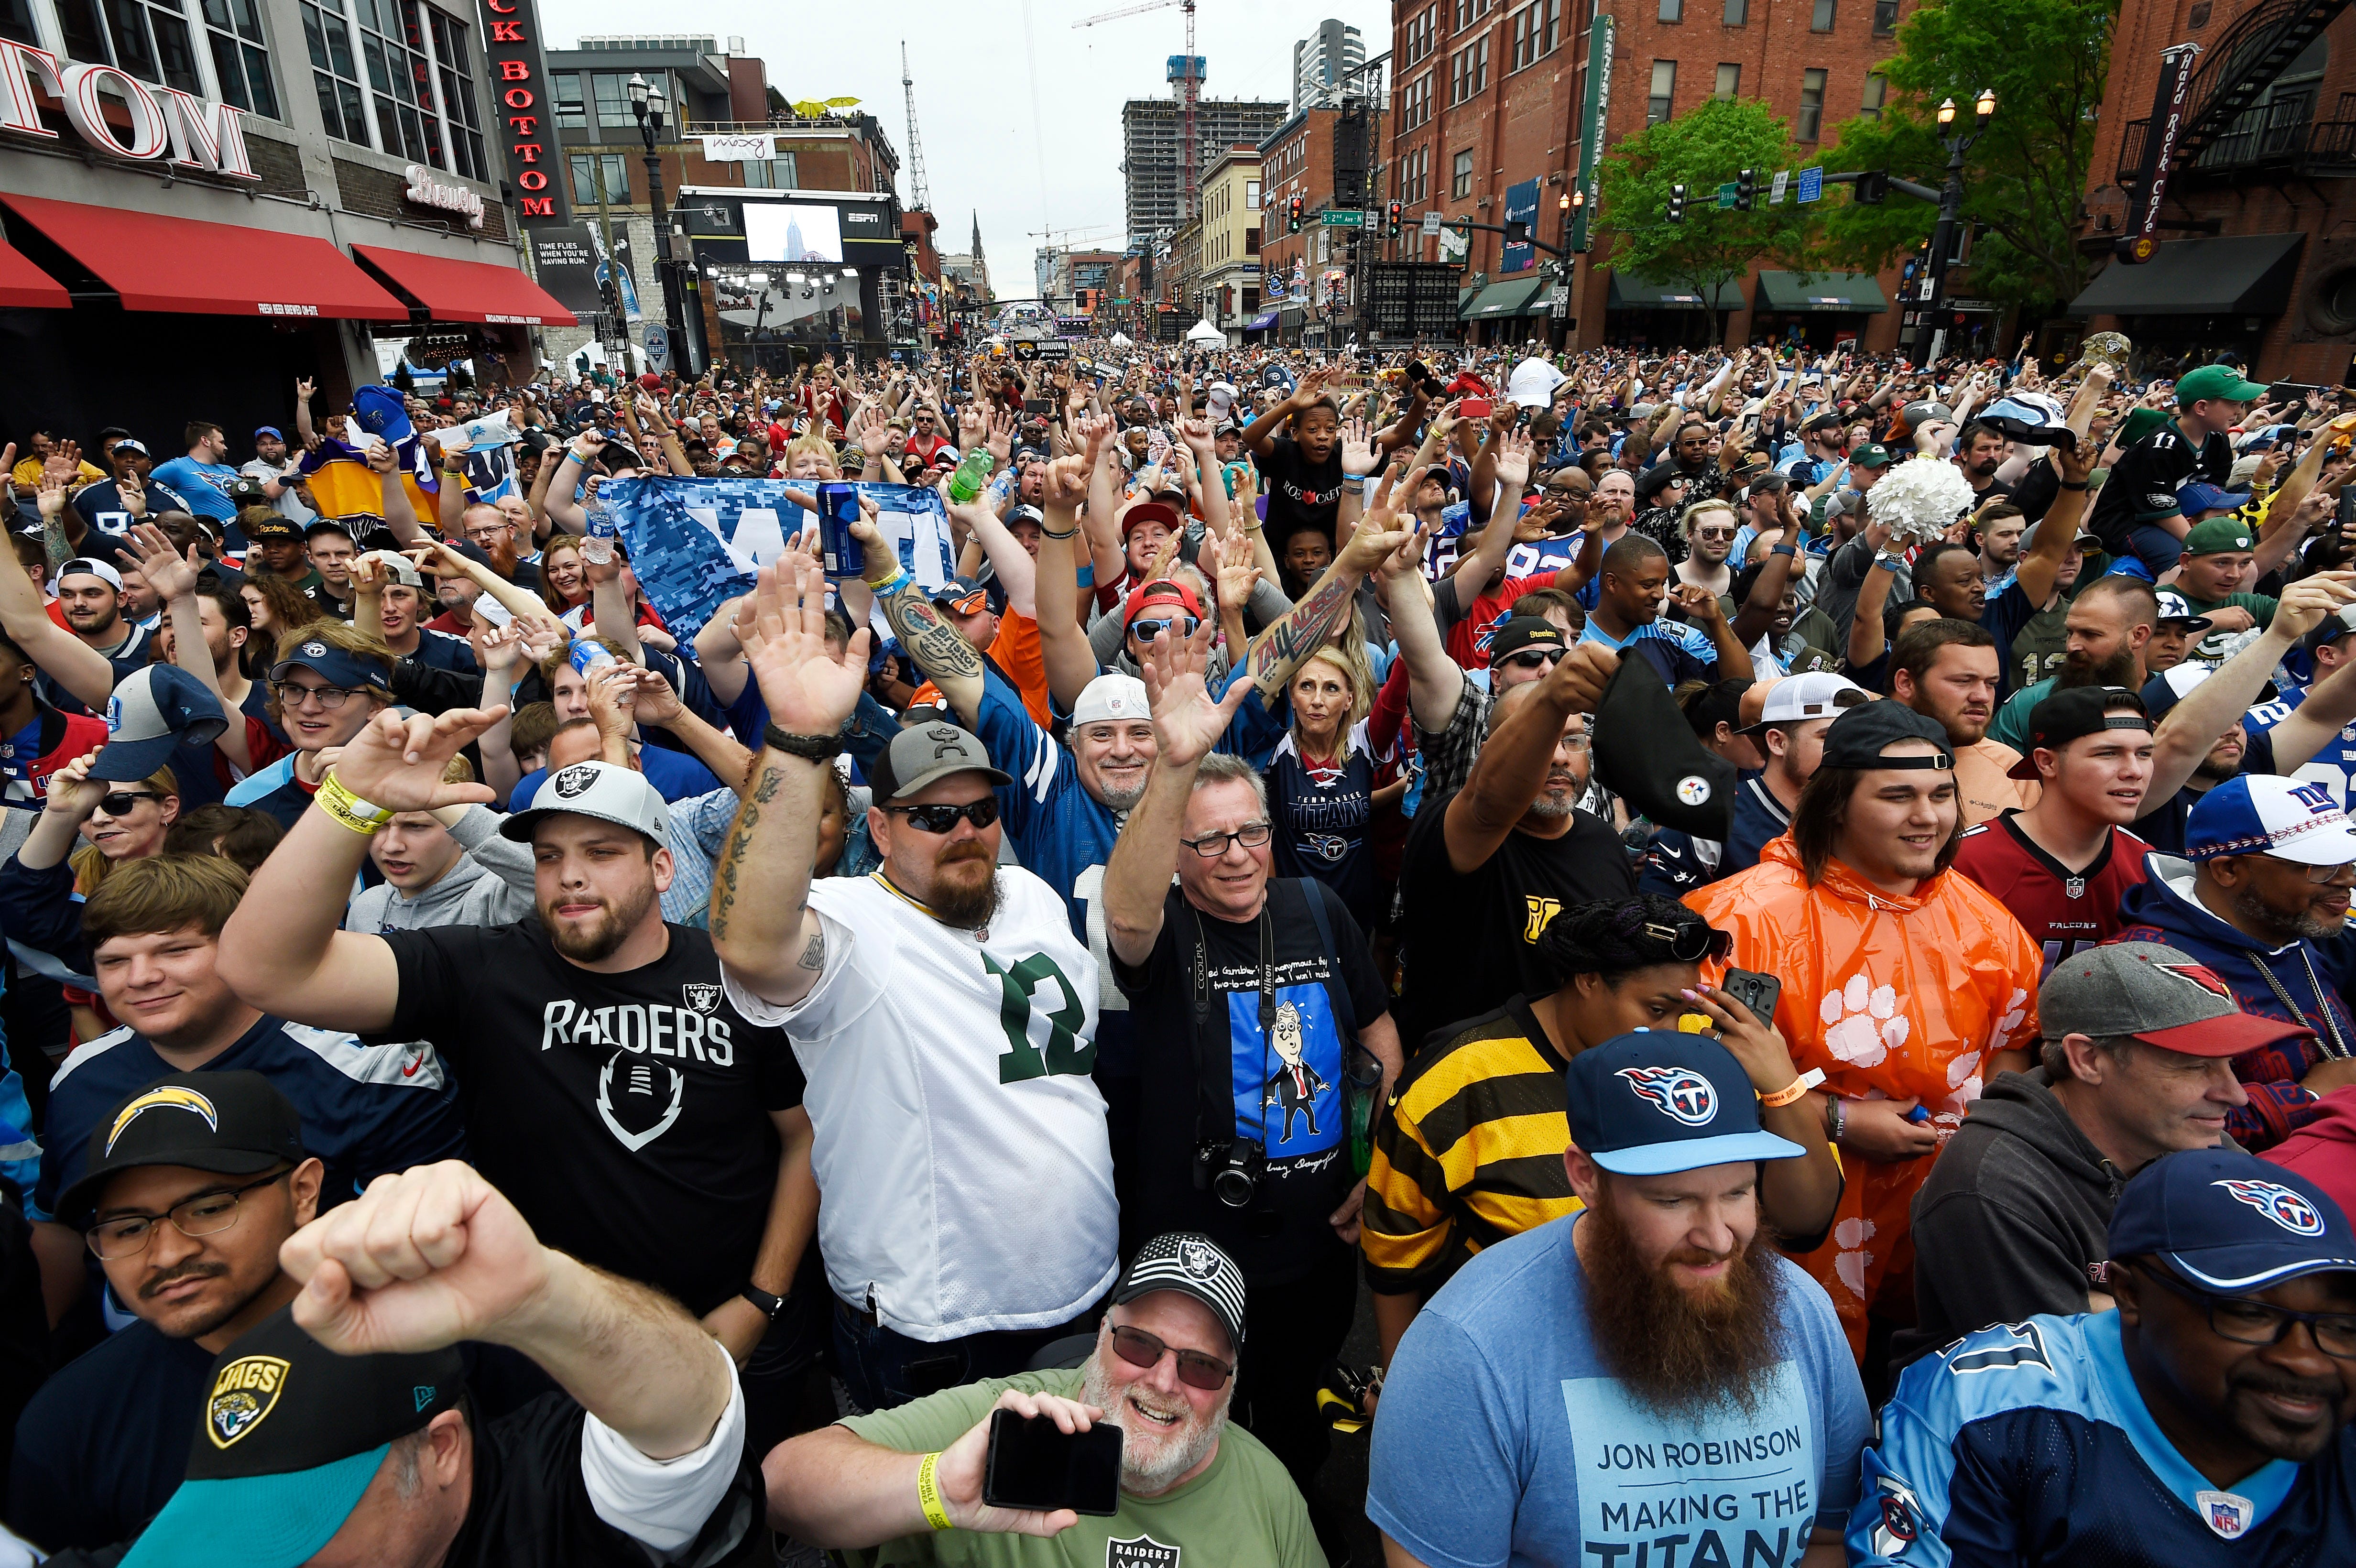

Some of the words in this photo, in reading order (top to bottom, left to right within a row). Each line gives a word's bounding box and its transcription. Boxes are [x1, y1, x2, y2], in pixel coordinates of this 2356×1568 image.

[2181, 54, 2193, 105] Hard
[499, 60, 556, 216] BOTTOM
[2159, 114, 2179, 171] Rock
[406, 164, 484, 229] Brewery
[2145, 180, 2164, 233] Cafe
[848, 213, 878, 223] ESPN
[541, 258, 568, 266] HAVING
[569, 257, 588, 265] RUM.
[563, 250, 589, 258] YOU'RE
[258, 303, 273, 314] FRESH
[273, 305, 284, 315] BEER
[284, 305, 302, 315] BREWED
[1036, 341, 1068, 351] #DUUUVAL
[1094, 362, 1124, 378] #DUUUVAL
[2152, 432, 2176, 450] 11
[259, 524, 290, 535] Packers
[1255, 576, 1348, 677] TALLADEGA
[1530, 630, 1557, 639] Steelers
[927, 632, 947, 647] Motor
[945, 646, 970, 670] Speedway
[934, 625, 977, 669] Bristol
[1287, 799, 1370, 830] TITANS
[1586, 795, 1594, 809] 19
[2068, 886, 2083, 895] NFL
[974, 930, 986, 938] NFL
[1195, 941, 1205, 989] COOLPIX
[1275, 959, 1318, 972] nonymous...
[1213, 978, 1260, 990] two-to-one
[1288, 971, 1293, 981] I
[1295, 969, 1313, 981] won't
[1315, 968, 1331, 979] make
[1264, 964, 1272, 995] Nikon
[980, 951, 1098, 1085] 12
[541, 999, 734, 1067] RAIDERS
[1184, 1244, 1219, 1261] RAIDERS
[216, 1362, 281, 1394] JAGS
[1597, 1444, 1656, 1470] JON
[1663, 1425, 1801, 1469] ROBINSON
[919, 1455, 929, 1482] VIEWING
[925, 1454, 935, 1503] ACCESSIBLE
[920, 1484, 928, 1505] AREA
[1601, 1492, 1739, 1532] MAKING
[1751, 1479, 1810, 1520] THE
[2214, 1516, 2240, 1534] NFL
[1115, 1544, 1172, 1560] RAIDERS
[1585, 1513, 1815, 1568] TITANS
